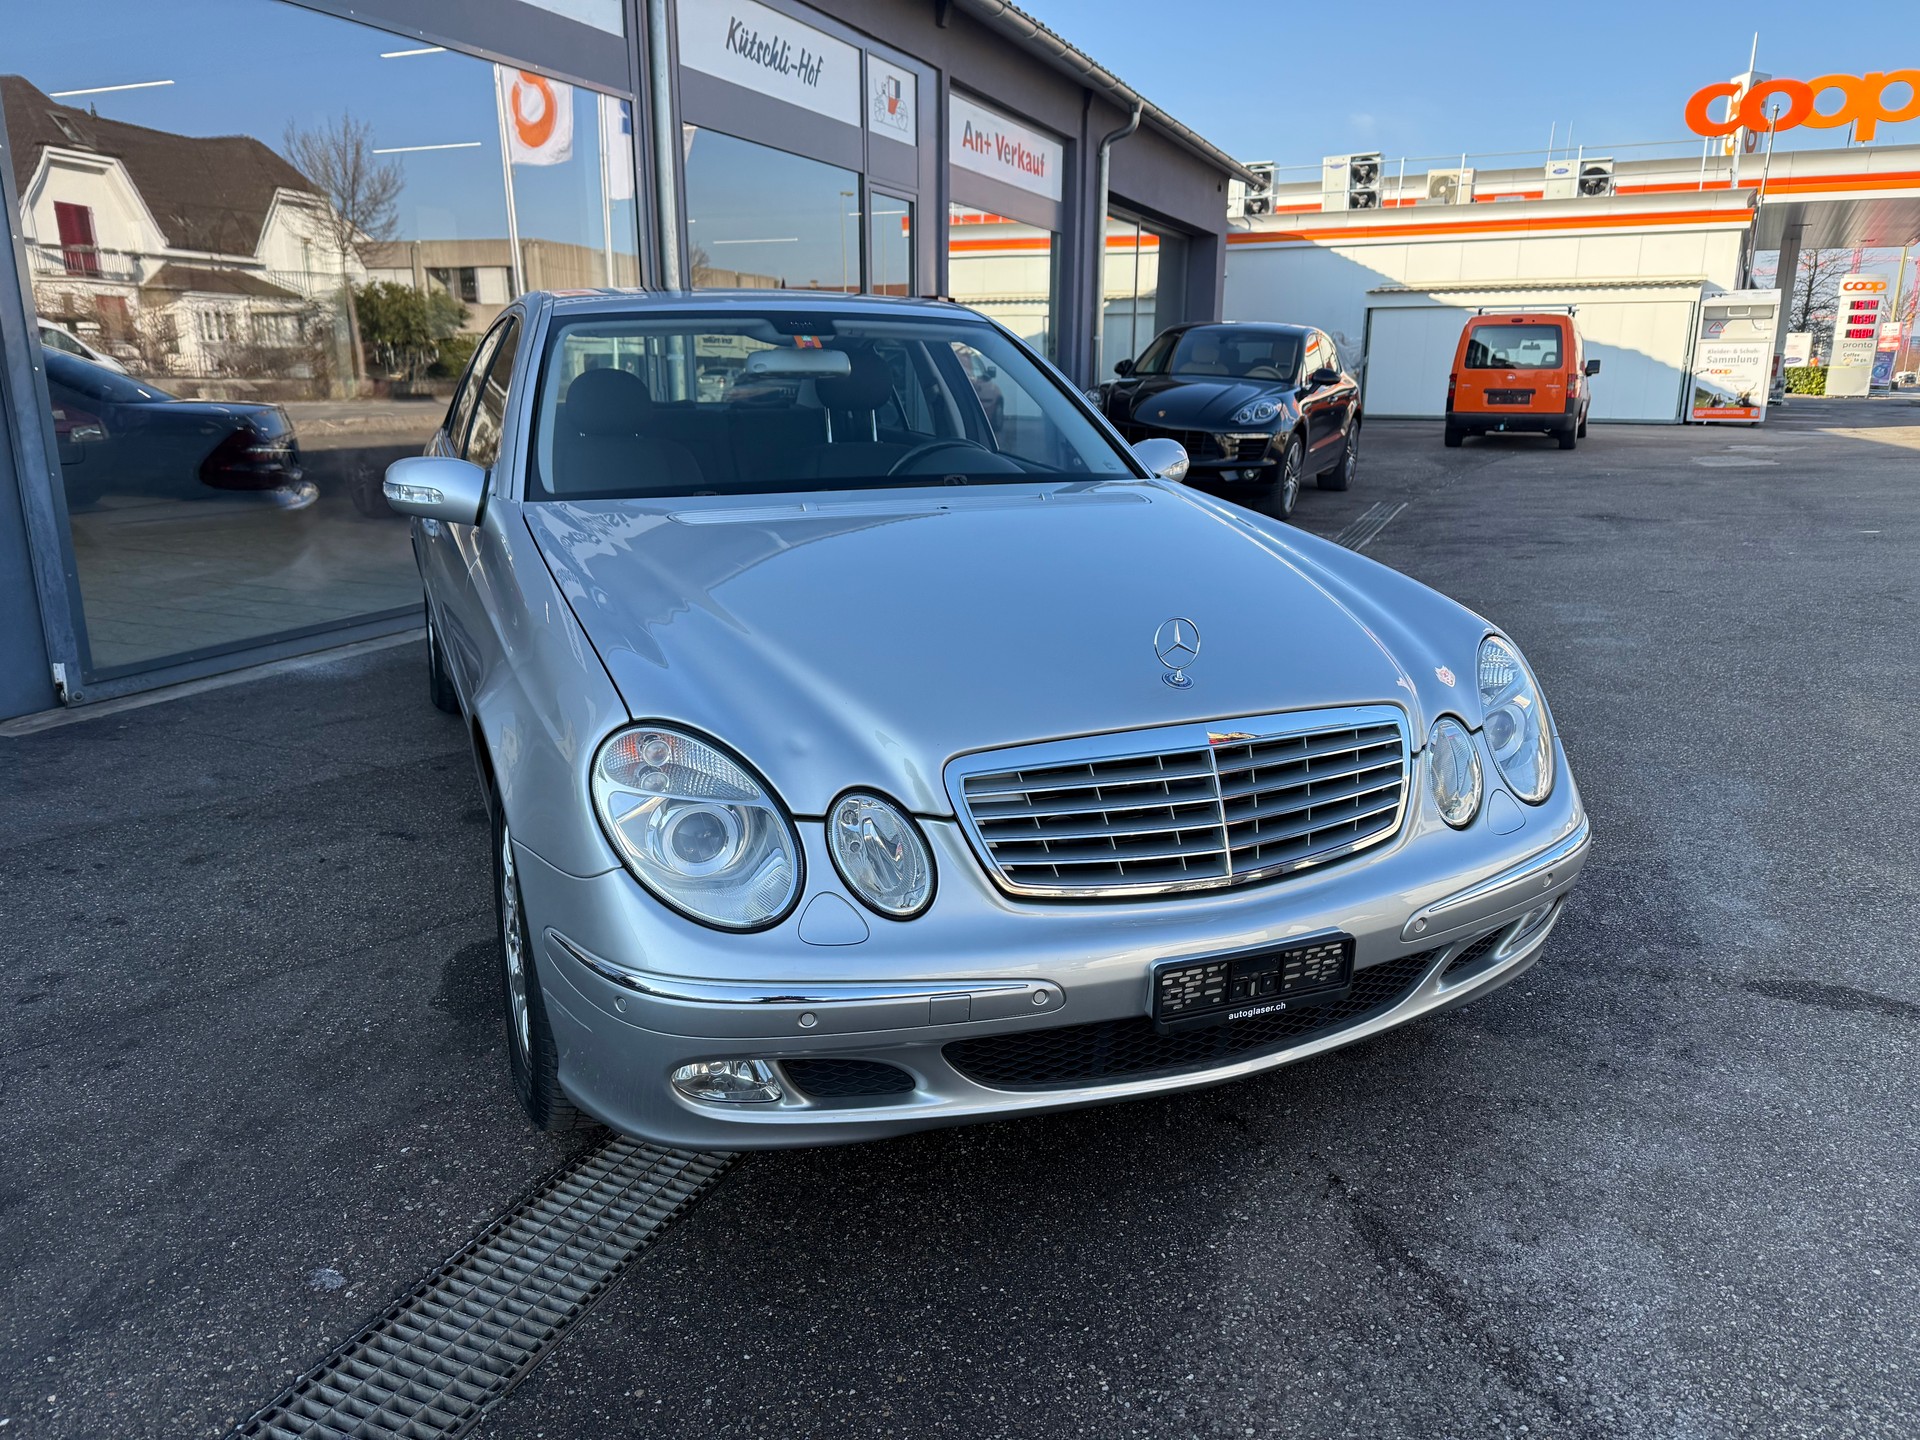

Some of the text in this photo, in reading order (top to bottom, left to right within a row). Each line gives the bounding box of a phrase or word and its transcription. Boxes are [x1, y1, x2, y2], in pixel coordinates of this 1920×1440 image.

[726, 16, 824, 88] Kütschli-Hof
[1685, 69, 1920, 142] coop
[995, 132, 1046, 178] Verkauf
[1843, 281, 1887, 293] coop
[1706, 355, 1759, 365] Sammlung
[1228, 1002, 1286, 1019] autoglaser.ch
